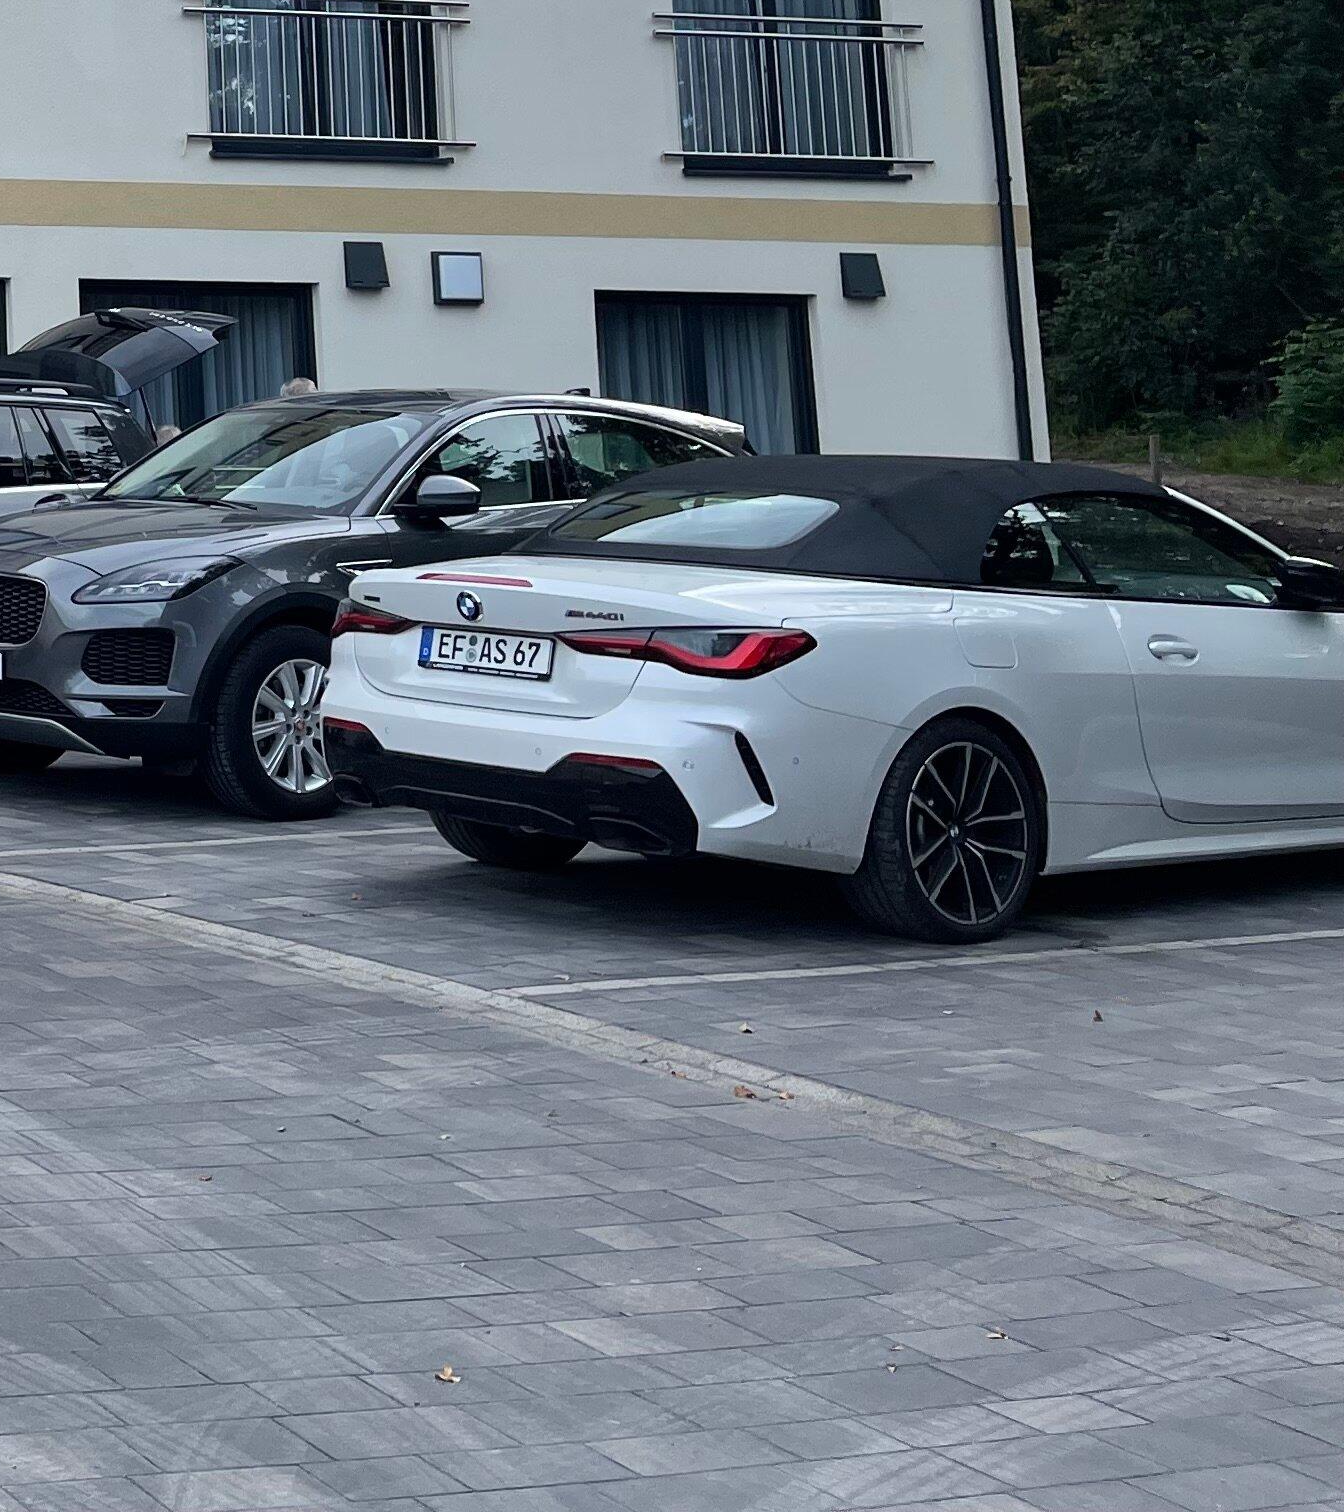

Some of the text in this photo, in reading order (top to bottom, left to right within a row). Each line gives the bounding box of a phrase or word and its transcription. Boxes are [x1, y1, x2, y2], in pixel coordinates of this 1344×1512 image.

[437, 633, 467, 660] EF
[479, 637, 508, 664] AS
[513, 640, 541, 668] 67
